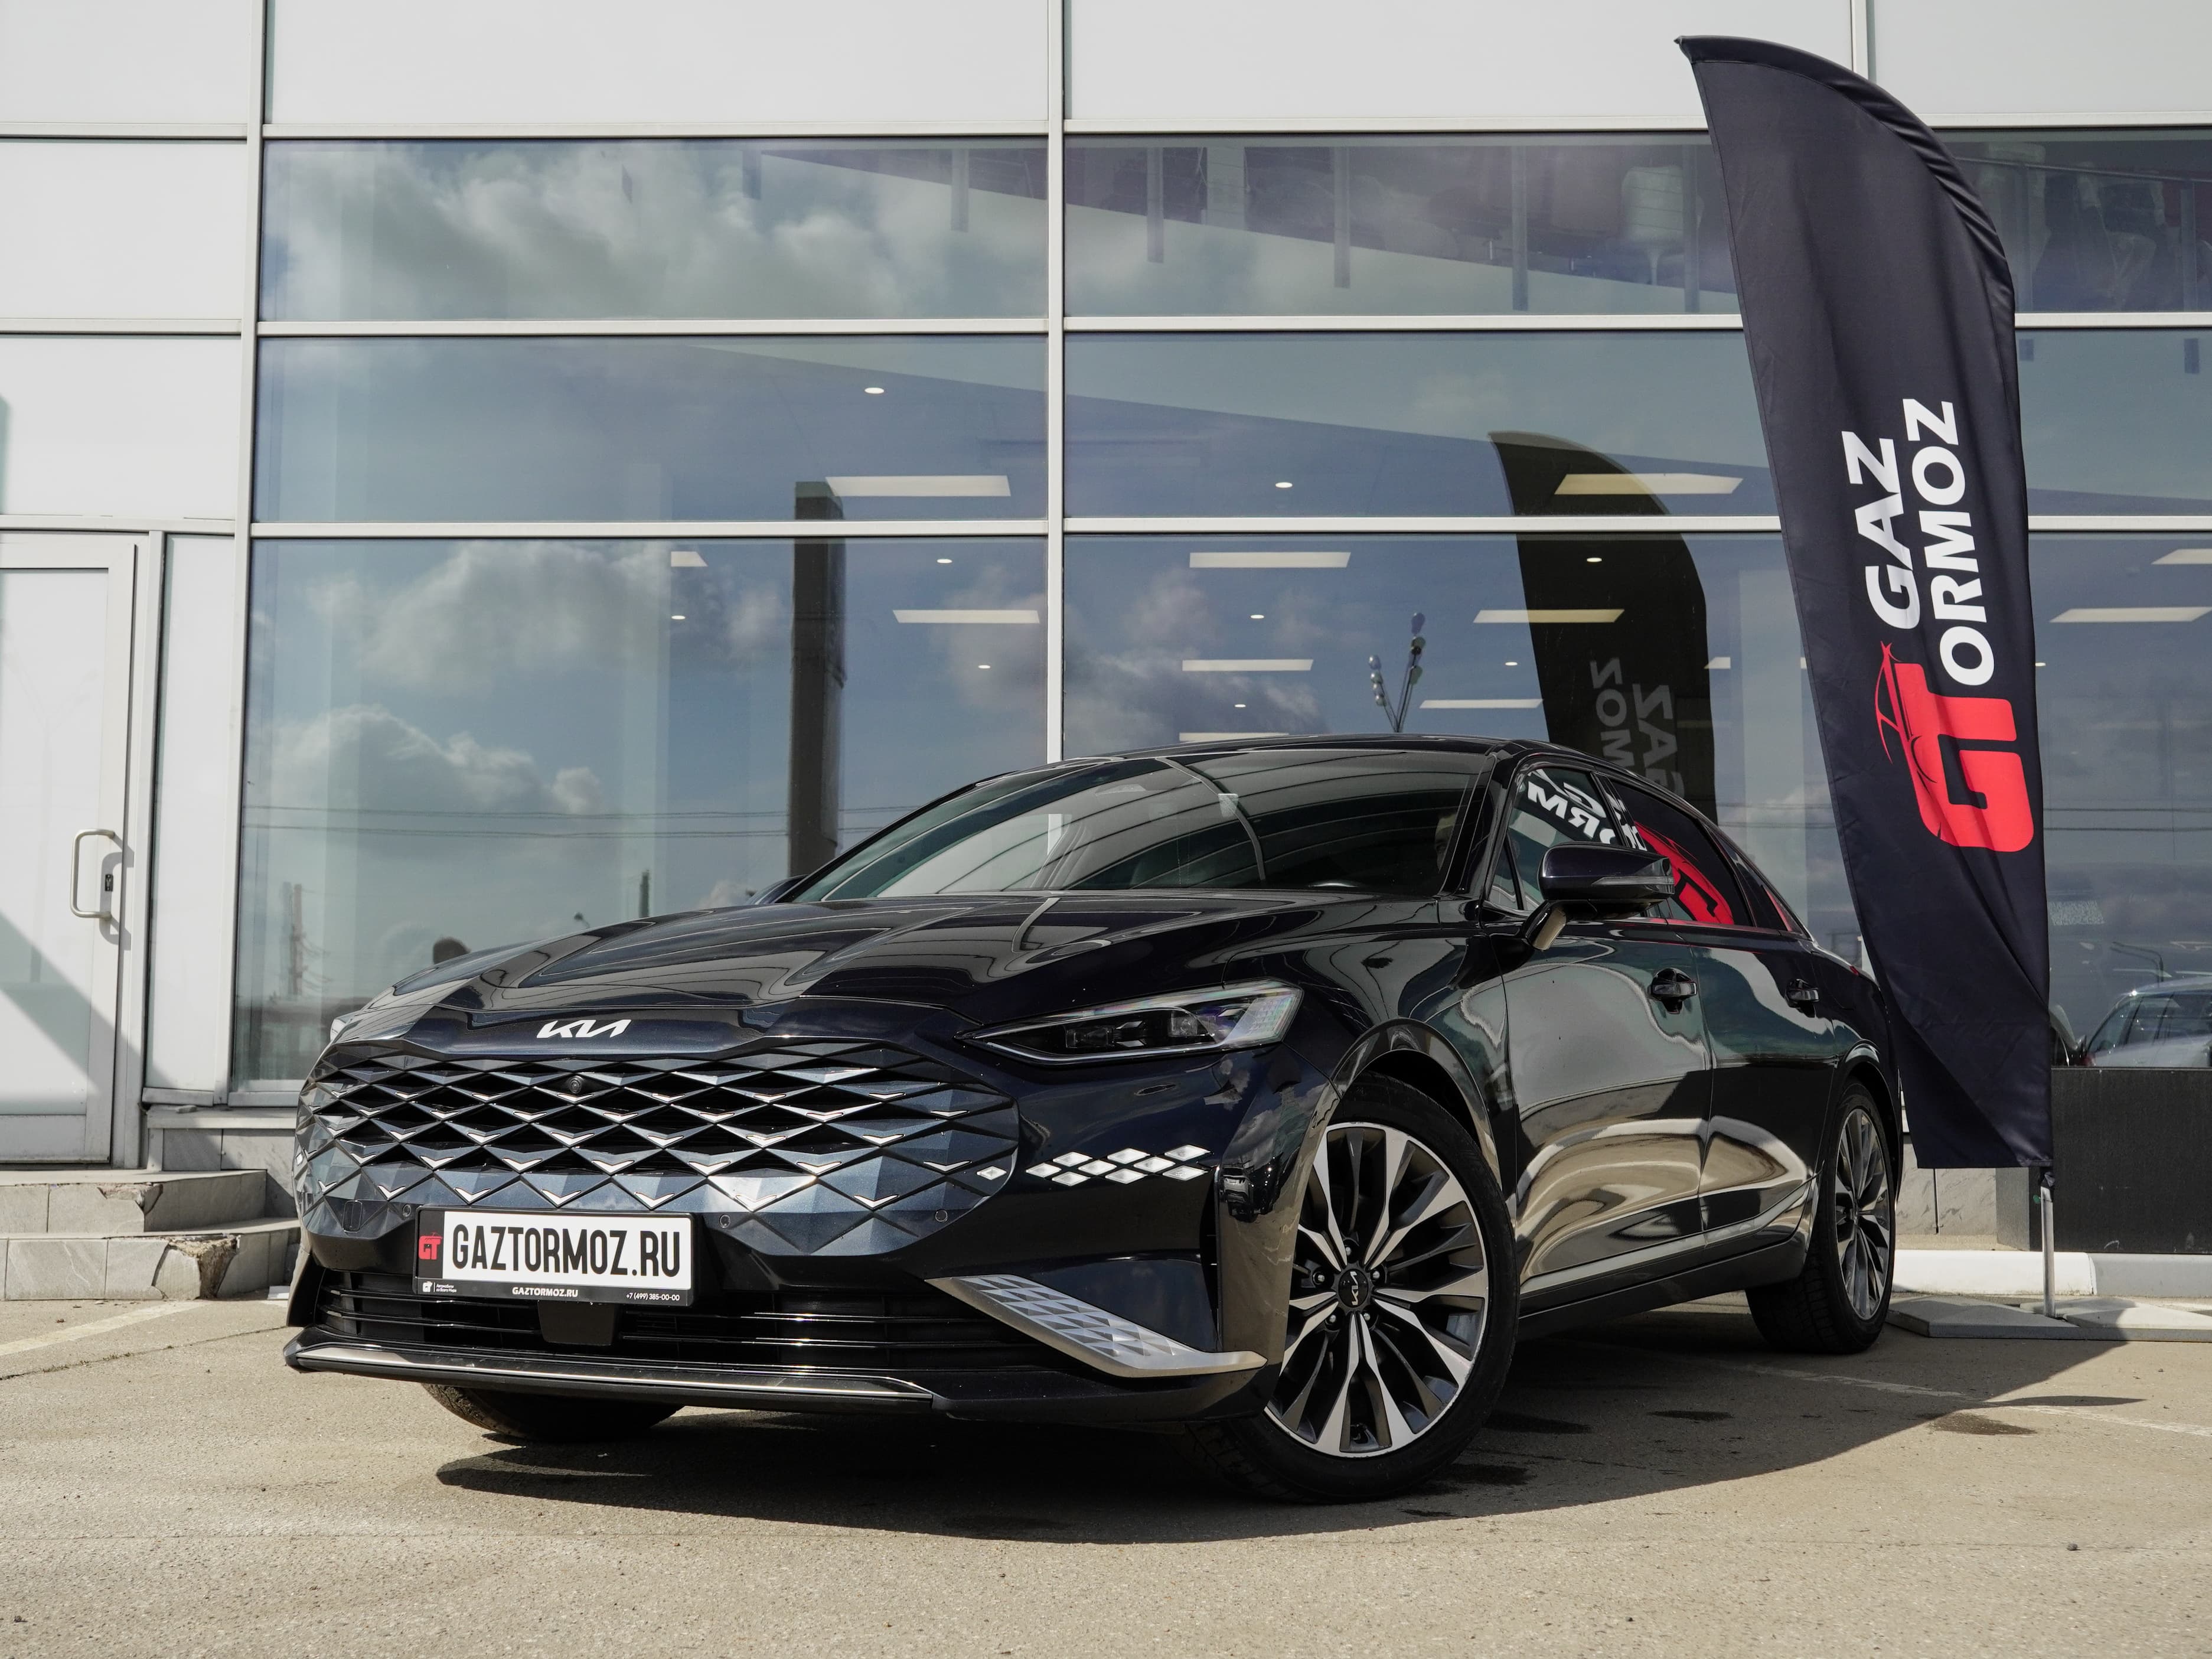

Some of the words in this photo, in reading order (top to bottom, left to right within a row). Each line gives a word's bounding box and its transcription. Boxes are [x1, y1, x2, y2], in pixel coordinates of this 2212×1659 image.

[1841, 431, 1920, 630] GAZ
[1903, 398, 1995, 686] ORMOZ
[536, 1013, 632, 1038] KIA
[452, 1224, 680, 1277] GAZTORMOZ.RU
[512, 1286, 579, 1298] GAZTORMOZ.RU
